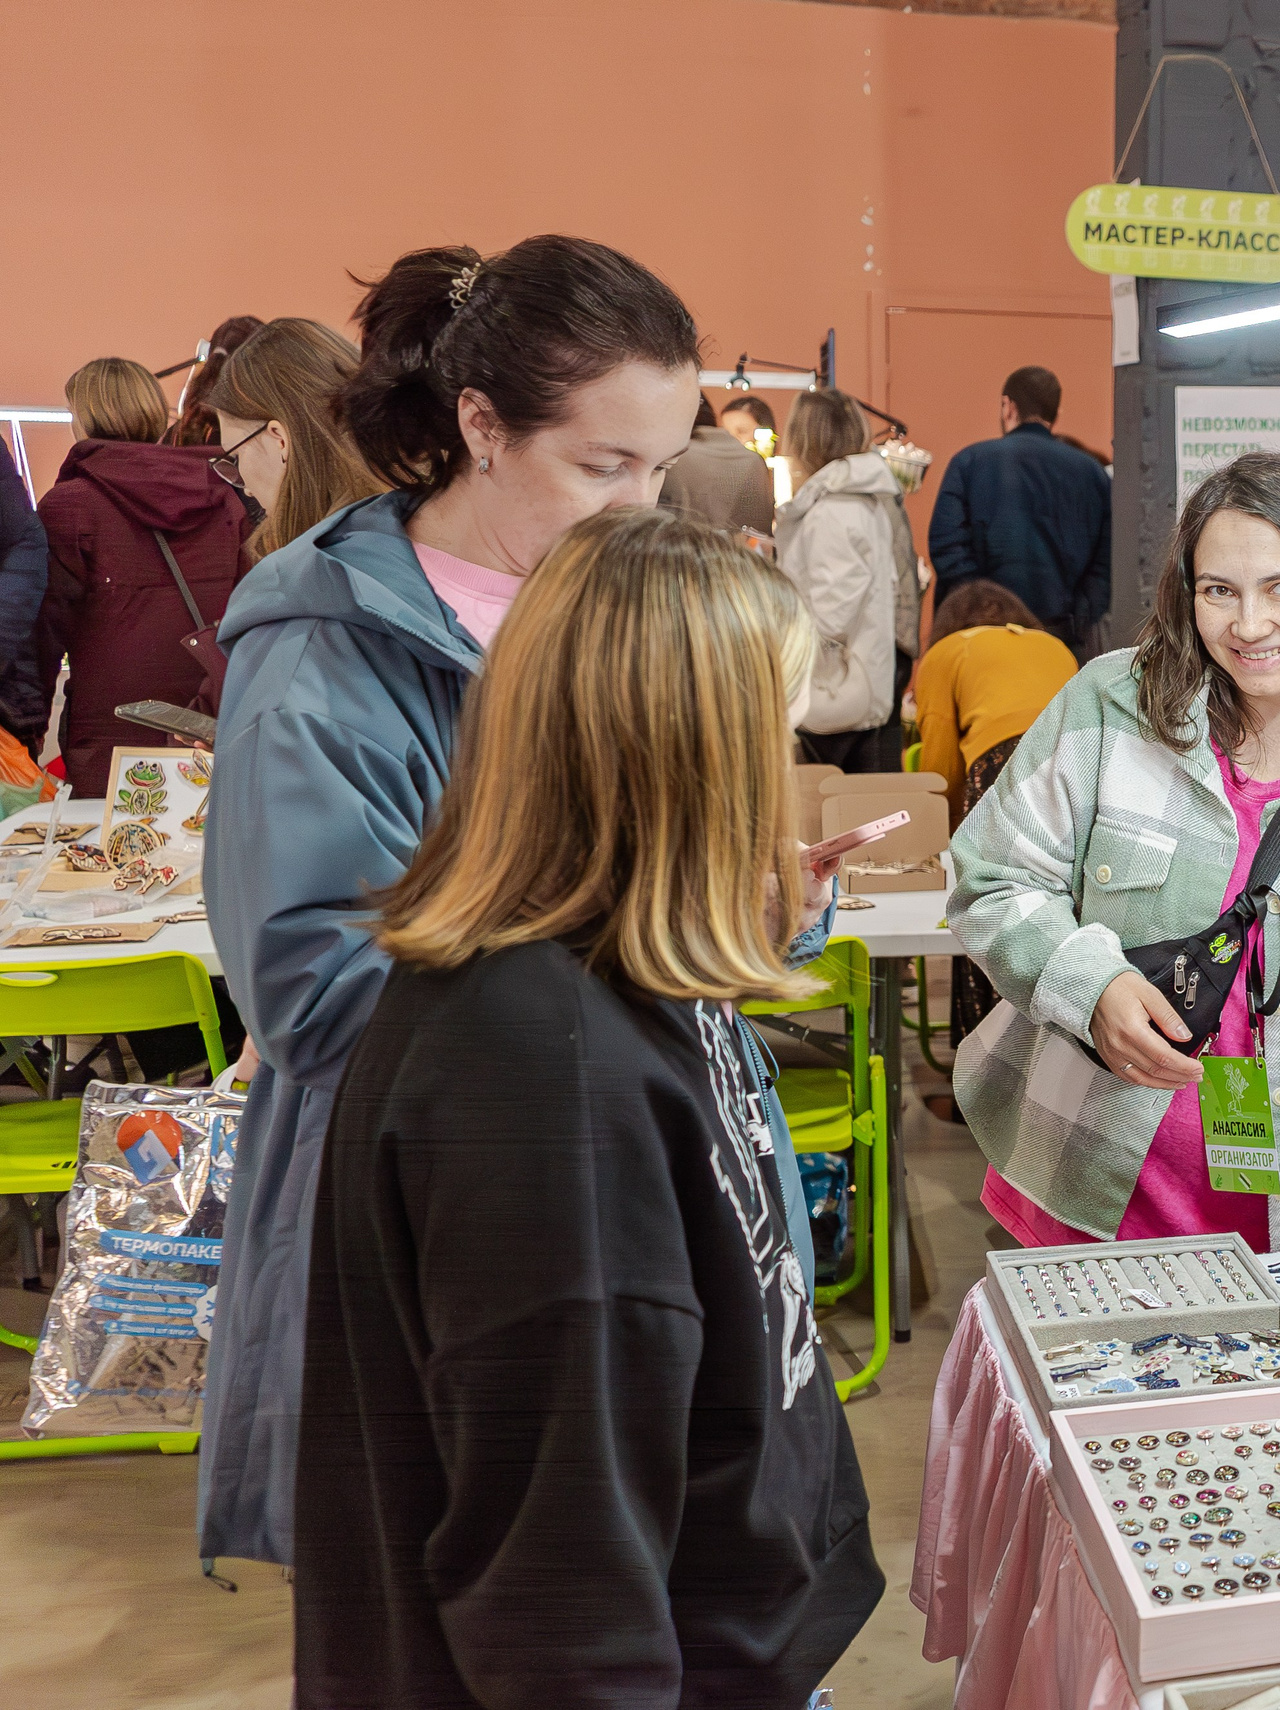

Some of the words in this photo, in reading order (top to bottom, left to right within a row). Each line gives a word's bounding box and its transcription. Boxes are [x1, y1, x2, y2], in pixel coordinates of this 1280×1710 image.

[1212, 1120, 1267, 1138] АНАСТАСИЯ
[1210, 1149, 1275, 1168] ОРГАНИЗАТОР
[111, 1236, 223, 1259] ТЕРМОПАКЕ
